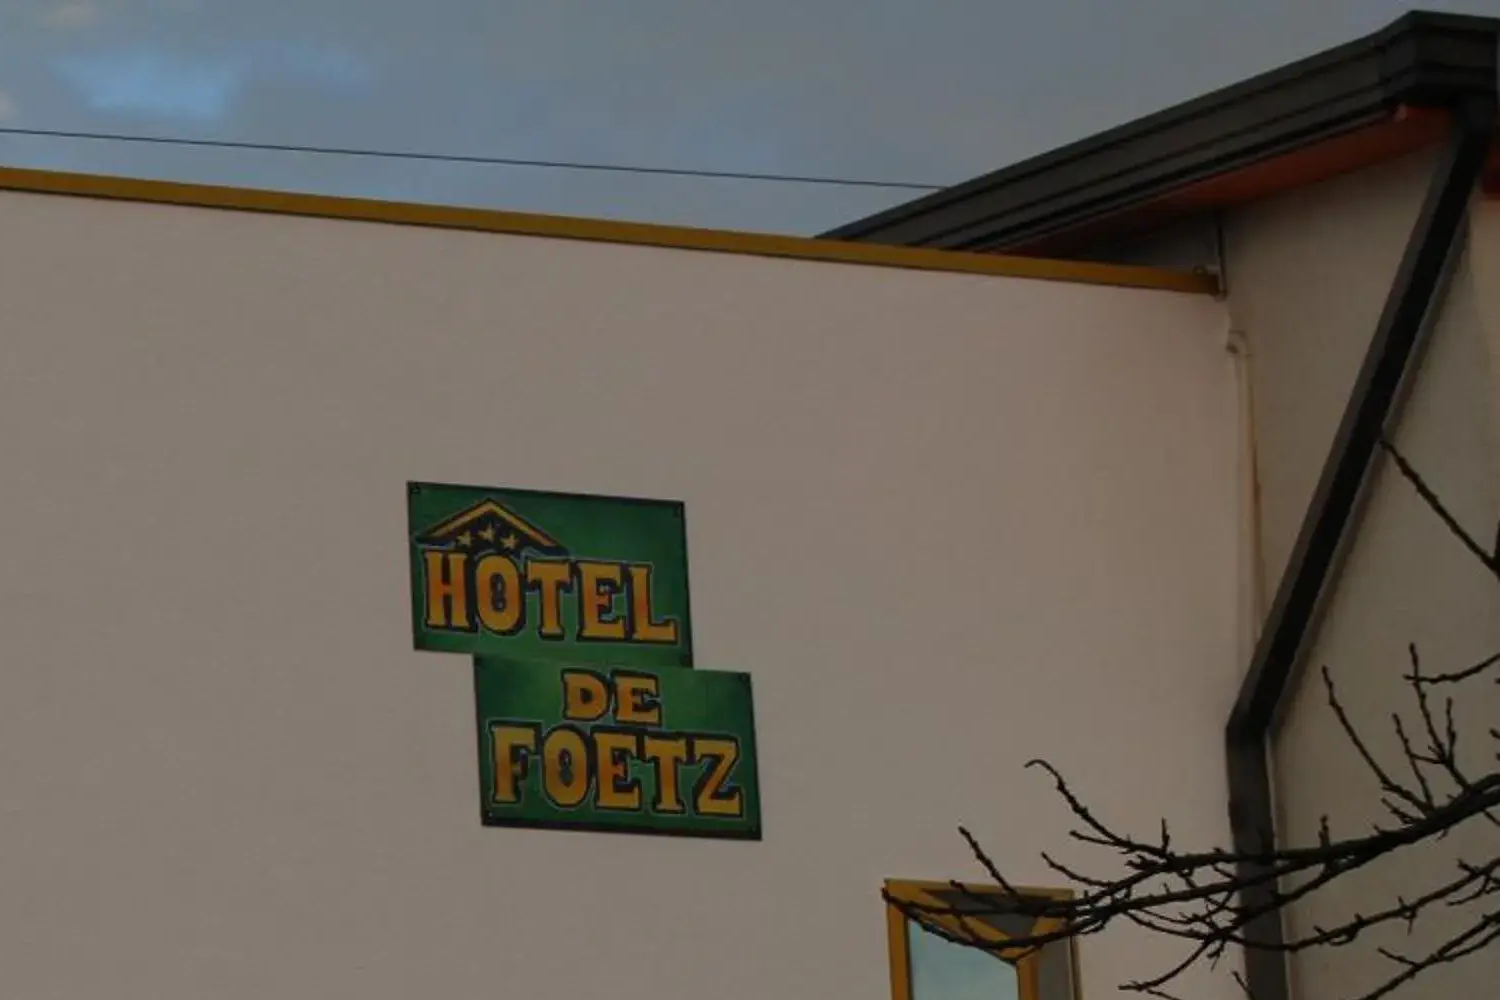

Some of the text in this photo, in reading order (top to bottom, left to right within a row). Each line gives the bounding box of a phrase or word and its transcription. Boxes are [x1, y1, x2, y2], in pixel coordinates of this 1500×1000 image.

[423, 548, 679, 645] HOTEL
[560, 667, 662, 727] DE
[489, 722, 744, 816] FOETZ
